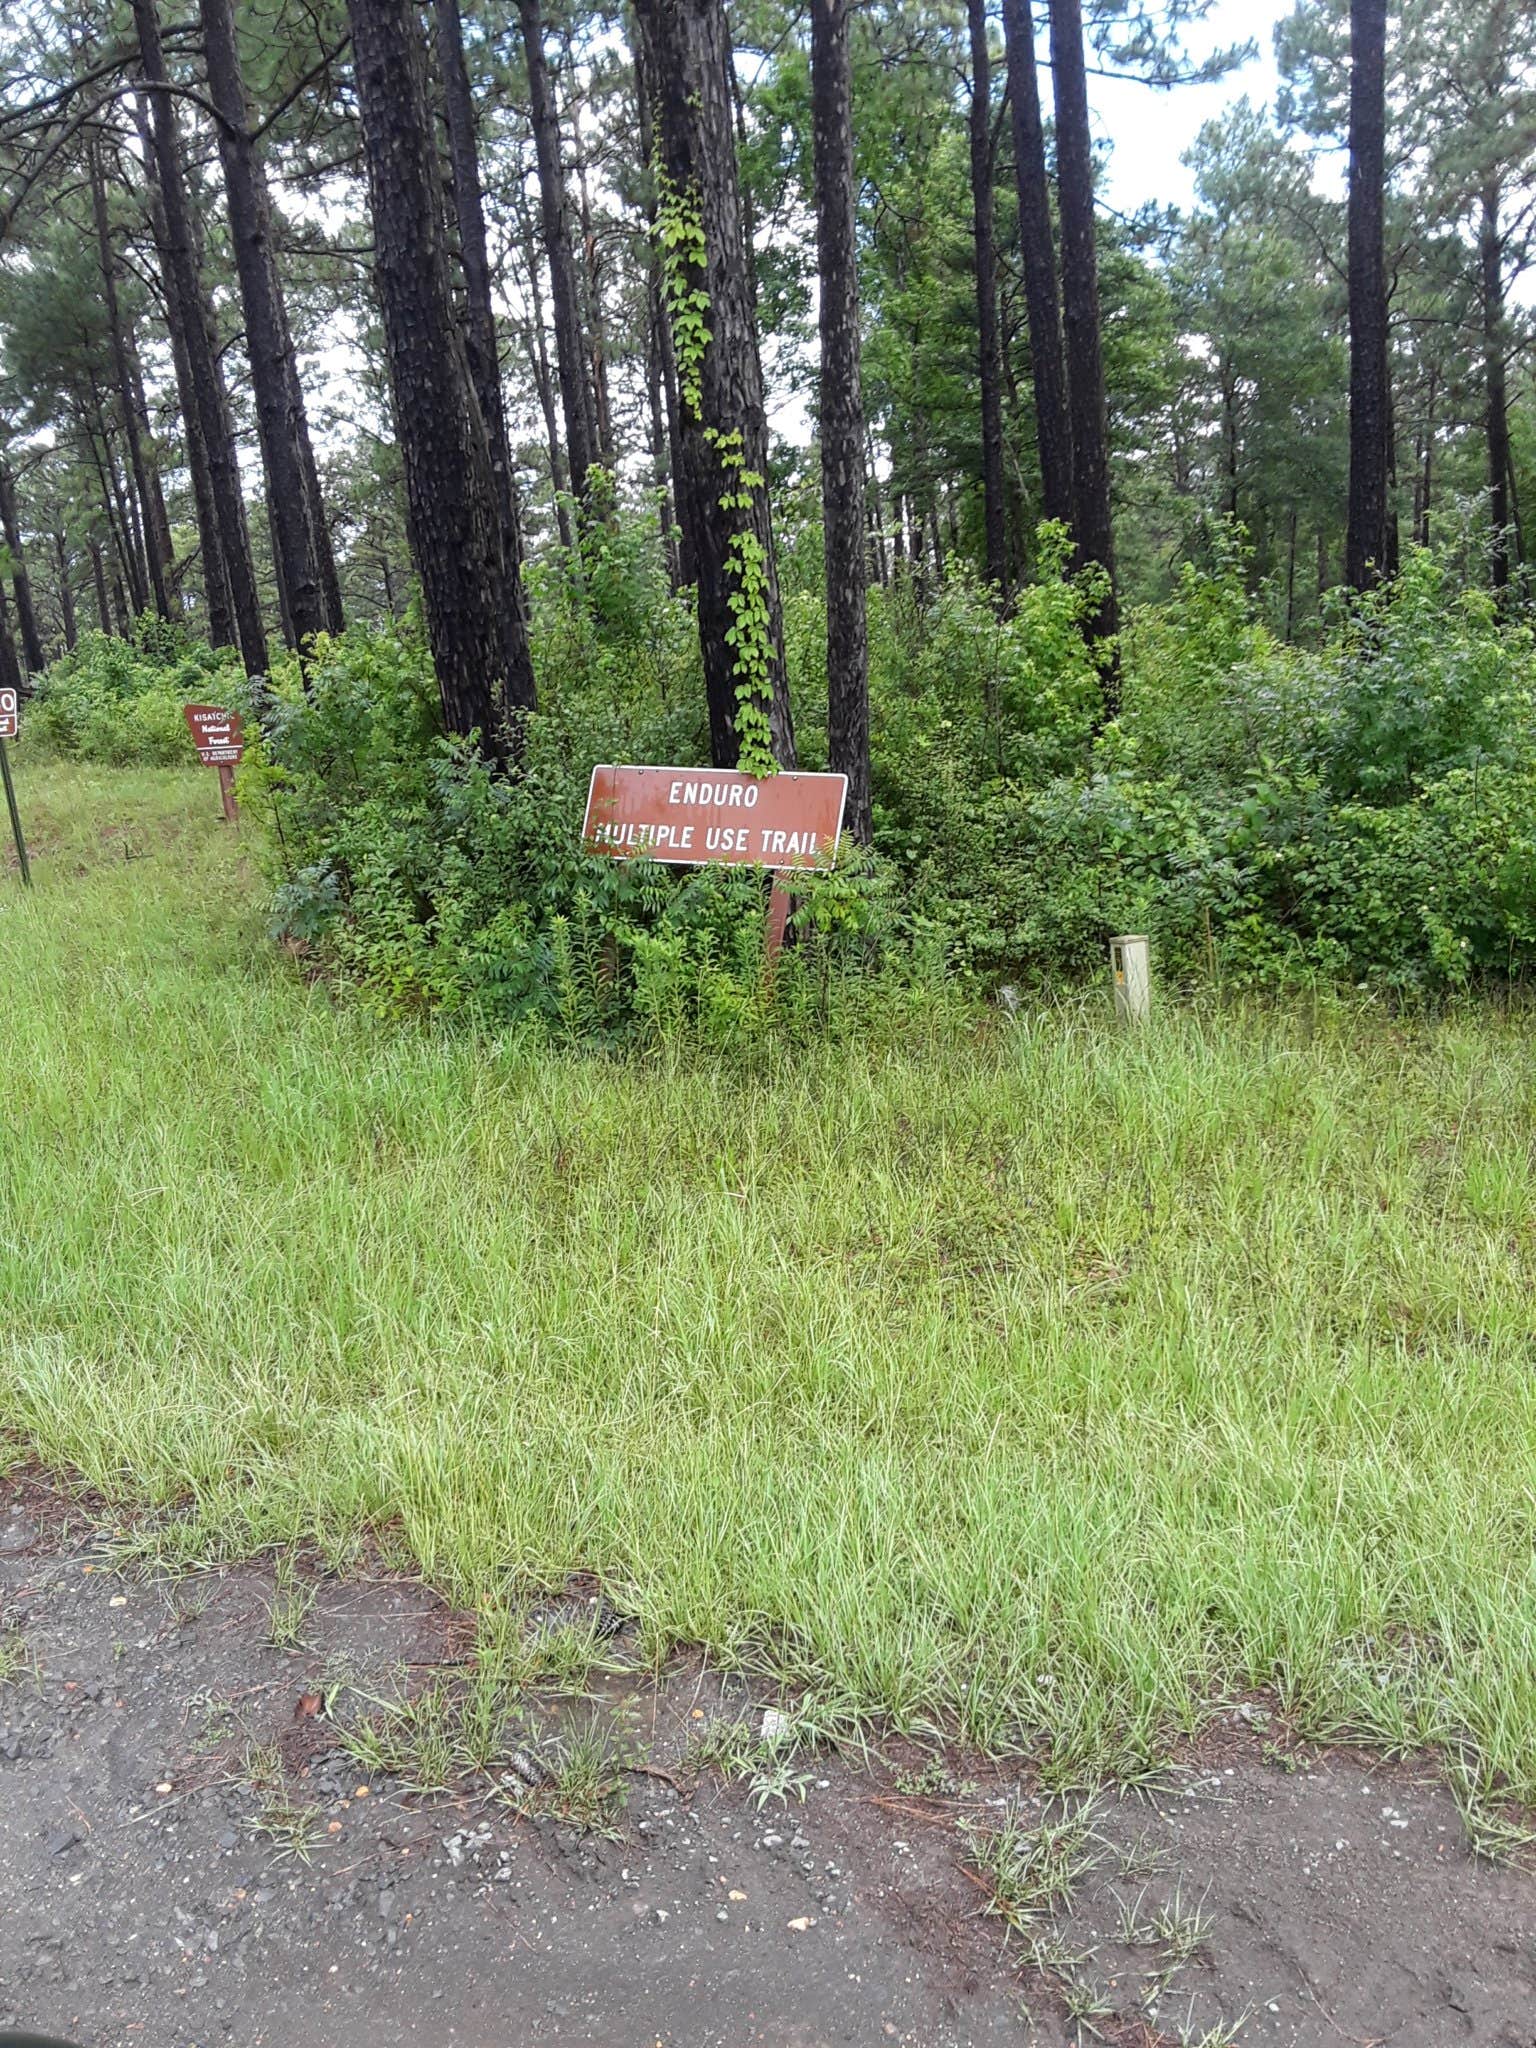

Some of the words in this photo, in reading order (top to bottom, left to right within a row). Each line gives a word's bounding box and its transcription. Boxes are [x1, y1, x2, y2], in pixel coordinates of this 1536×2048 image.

[668, 781, 759, 808] ENDURO
[595, 822, 695, 849] MULTIPLE
[705, 827, 750, 852] USE
[761, 829, 819, 855] TRAIL
